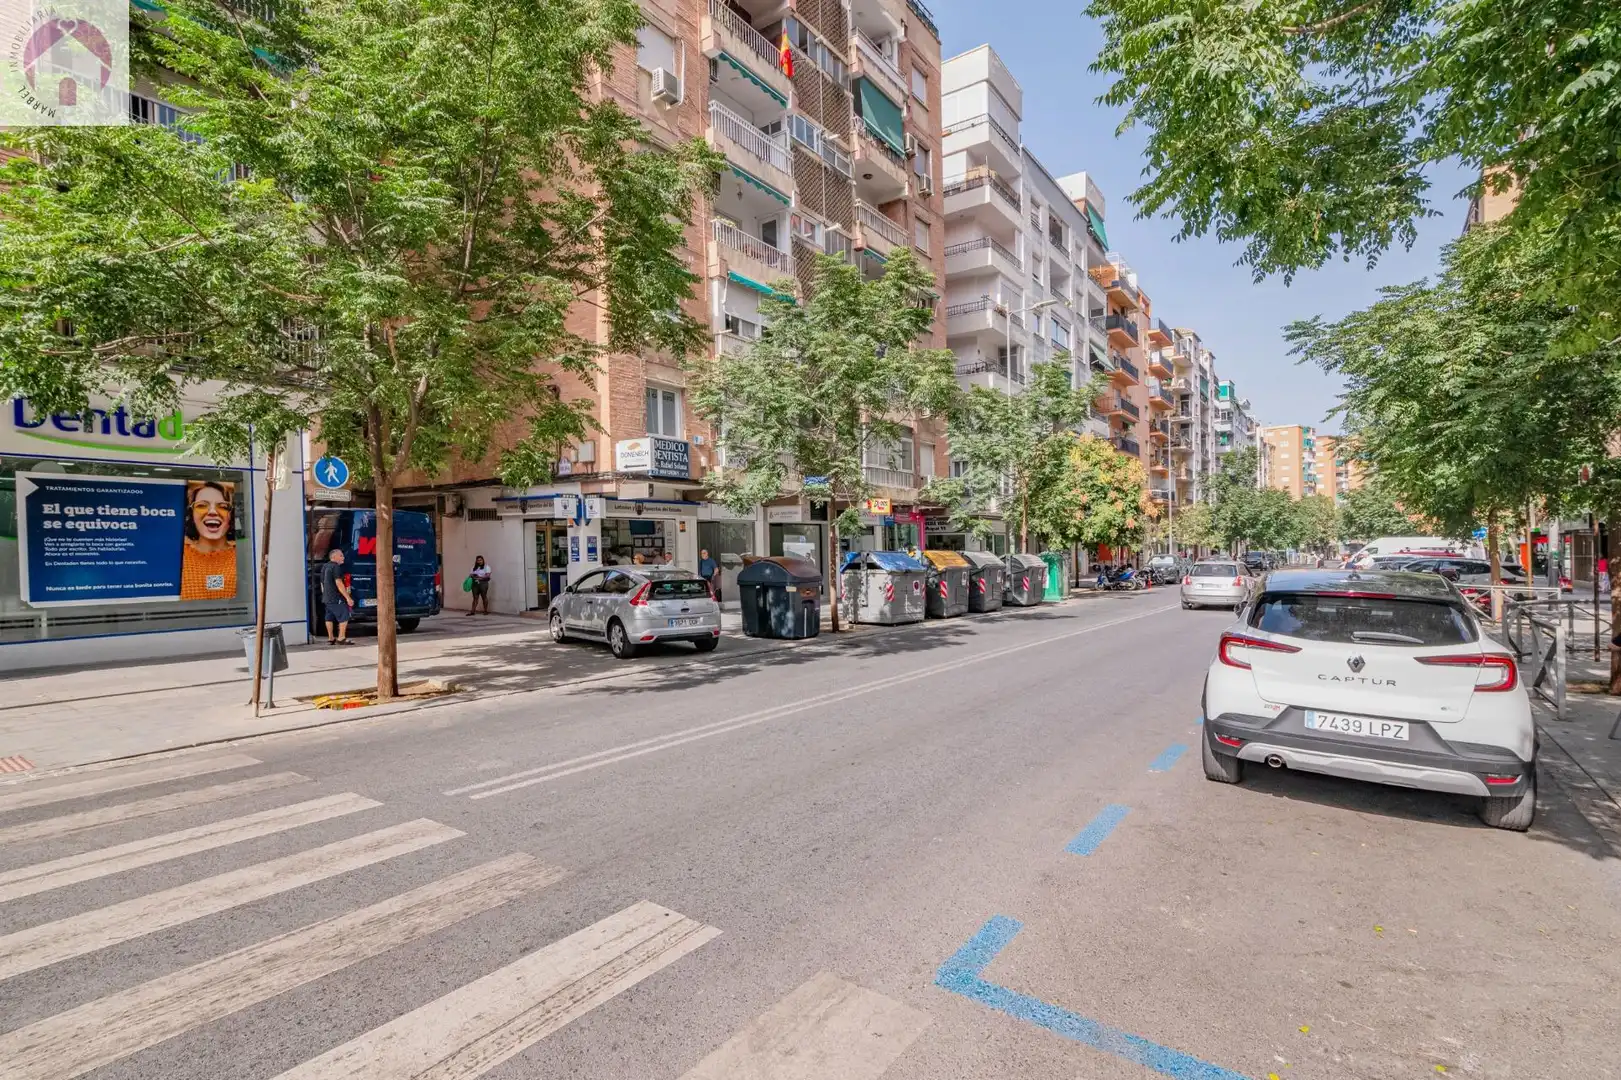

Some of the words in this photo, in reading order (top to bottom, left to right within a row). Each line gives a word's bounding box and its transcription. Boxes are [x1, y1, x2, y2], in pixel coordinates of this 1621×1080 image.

[42, 503, 61, 515] El
[64, 506, 95, 518] que
[97, 504, 138, 516] tiene
[140, 505, 176, 517] boca
[43, 520, 62, 529] se
[65, 518, 138, 531] equivoca
[1317, 673, 1398, 687] CAPTUR
[1317, 714, 1362, 733] 7439
[1369, 721, 1405, 739] LPZ
